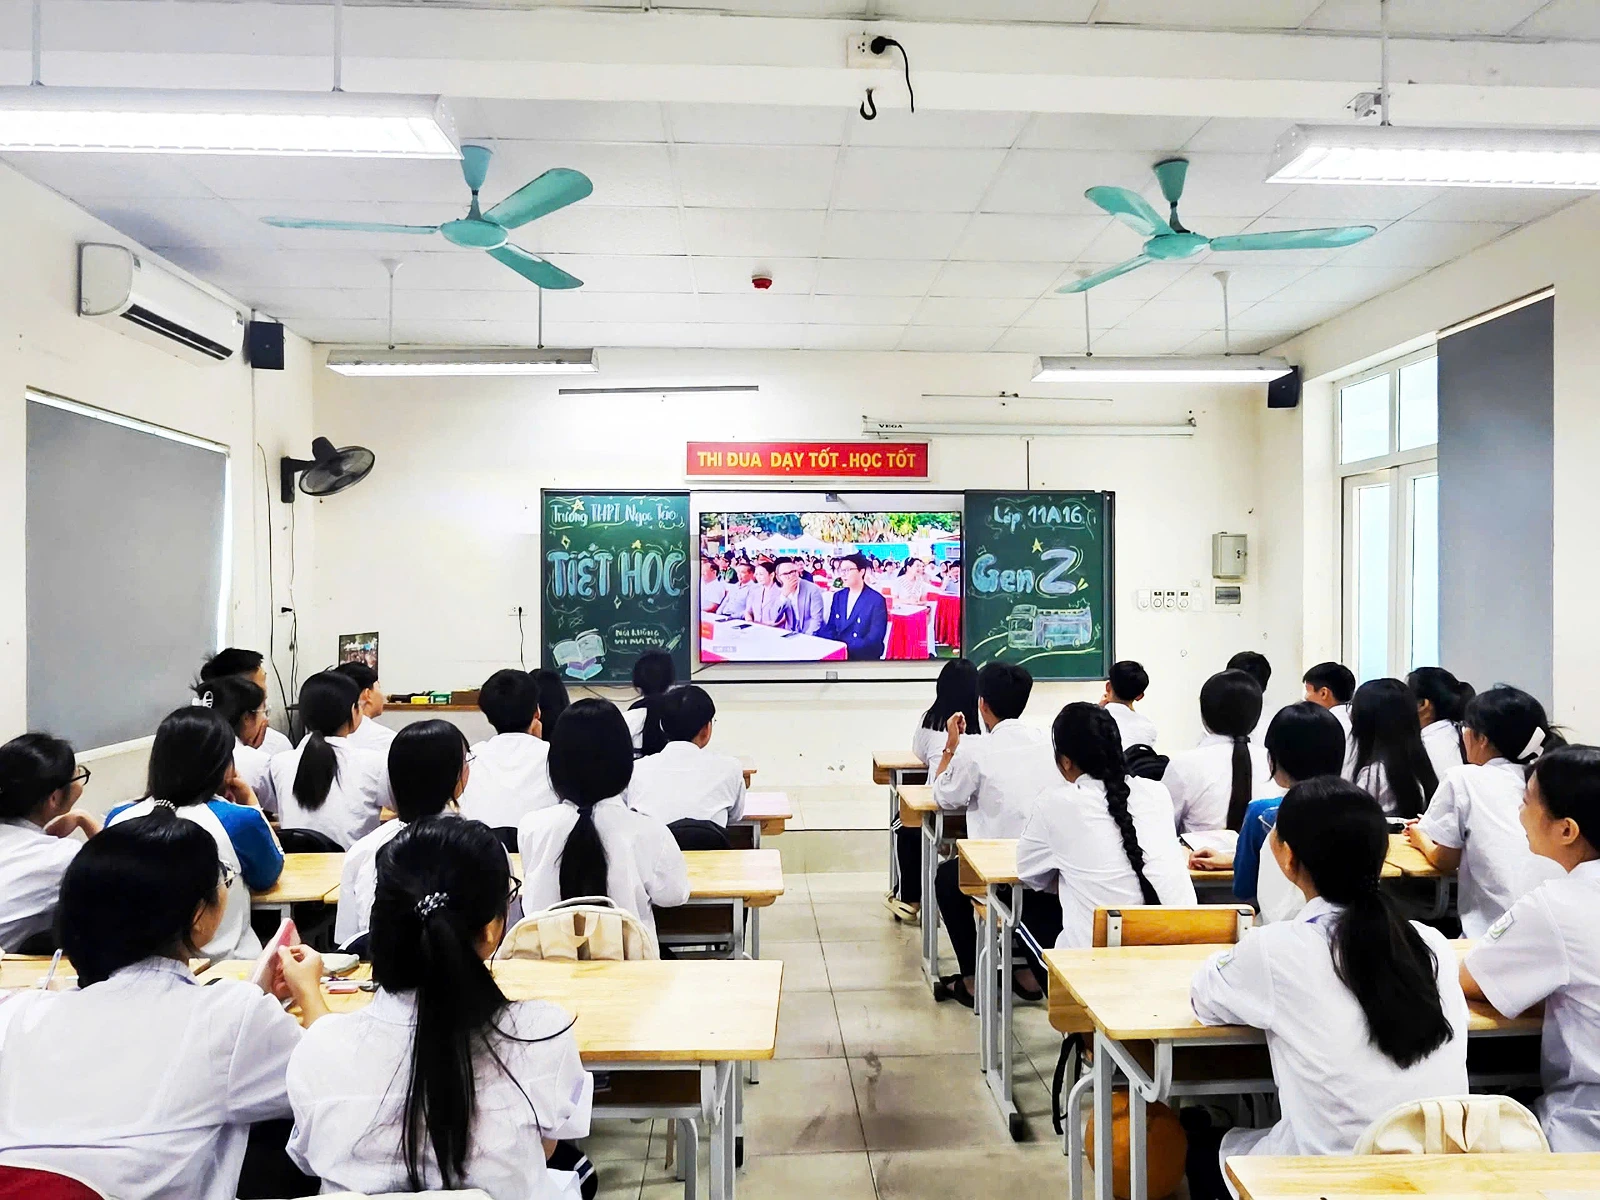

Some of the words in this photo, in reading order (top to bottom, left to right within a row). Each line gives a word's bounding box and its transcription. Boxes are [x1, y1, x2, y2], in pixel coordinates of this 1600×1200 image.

[697, 452, 722, 467] THI
[726, 452, 762, 468] ĐUA
[770, 452, 804, 471] DẠY
[808, 447, 839, 468] TỐT
[849, 453, 882, 471] HỌC
[886, 448, 916, 467] TỐT
[550, 504, 588, 527] Trường
[591, 503, 620, 522] THPT
[625, 504, 653, 526] Ngọc
[993, 506, 1021, 534] Lớp
[1027, 505, 1082, 524] 11A16
[547, 543, 614, 597] TIẾT
[621, 551, 685, 603] HỌC
[972, 553, 1034, 593] Gen
[1040, 548, 1078, 594] Z
